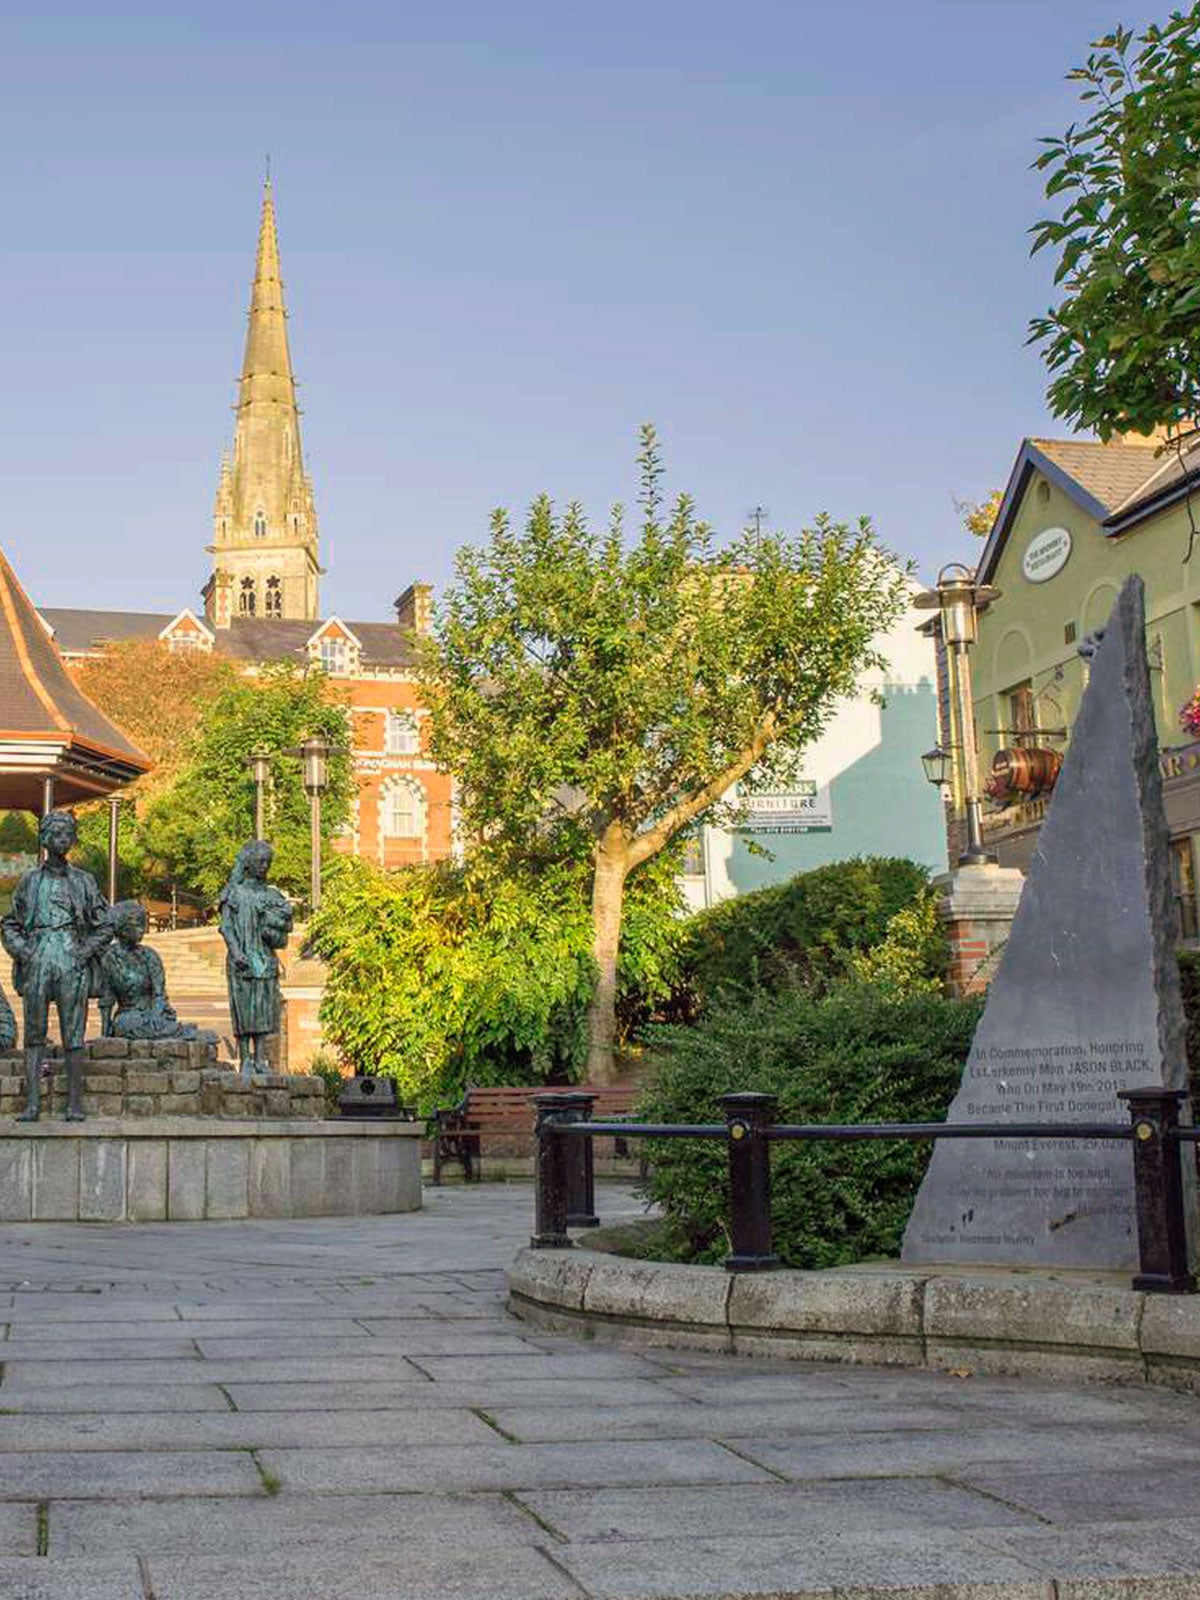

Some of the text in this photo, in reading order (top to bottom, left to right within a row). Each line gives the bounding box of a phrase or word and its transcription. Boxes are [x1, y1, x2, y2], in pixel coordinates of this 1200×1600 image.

[976, 1048, 987, 1060] In
[1089, 1041, 1144, 1055] Honoring
[970, 1065, 1037, 1079] Letterkenny
[1066, 1061, 1107, 1074] JASON
[1042, 1081, 1066, 1095] May
[967, 1102, 1012, 1115] Became
[1014, 1101, 1036, 1113] The
[1038, 1101, 1065, 1113] First
[1067, 1099, 1116, 1113] Donegal
[993, 1138, 1031, 1152] Mount
